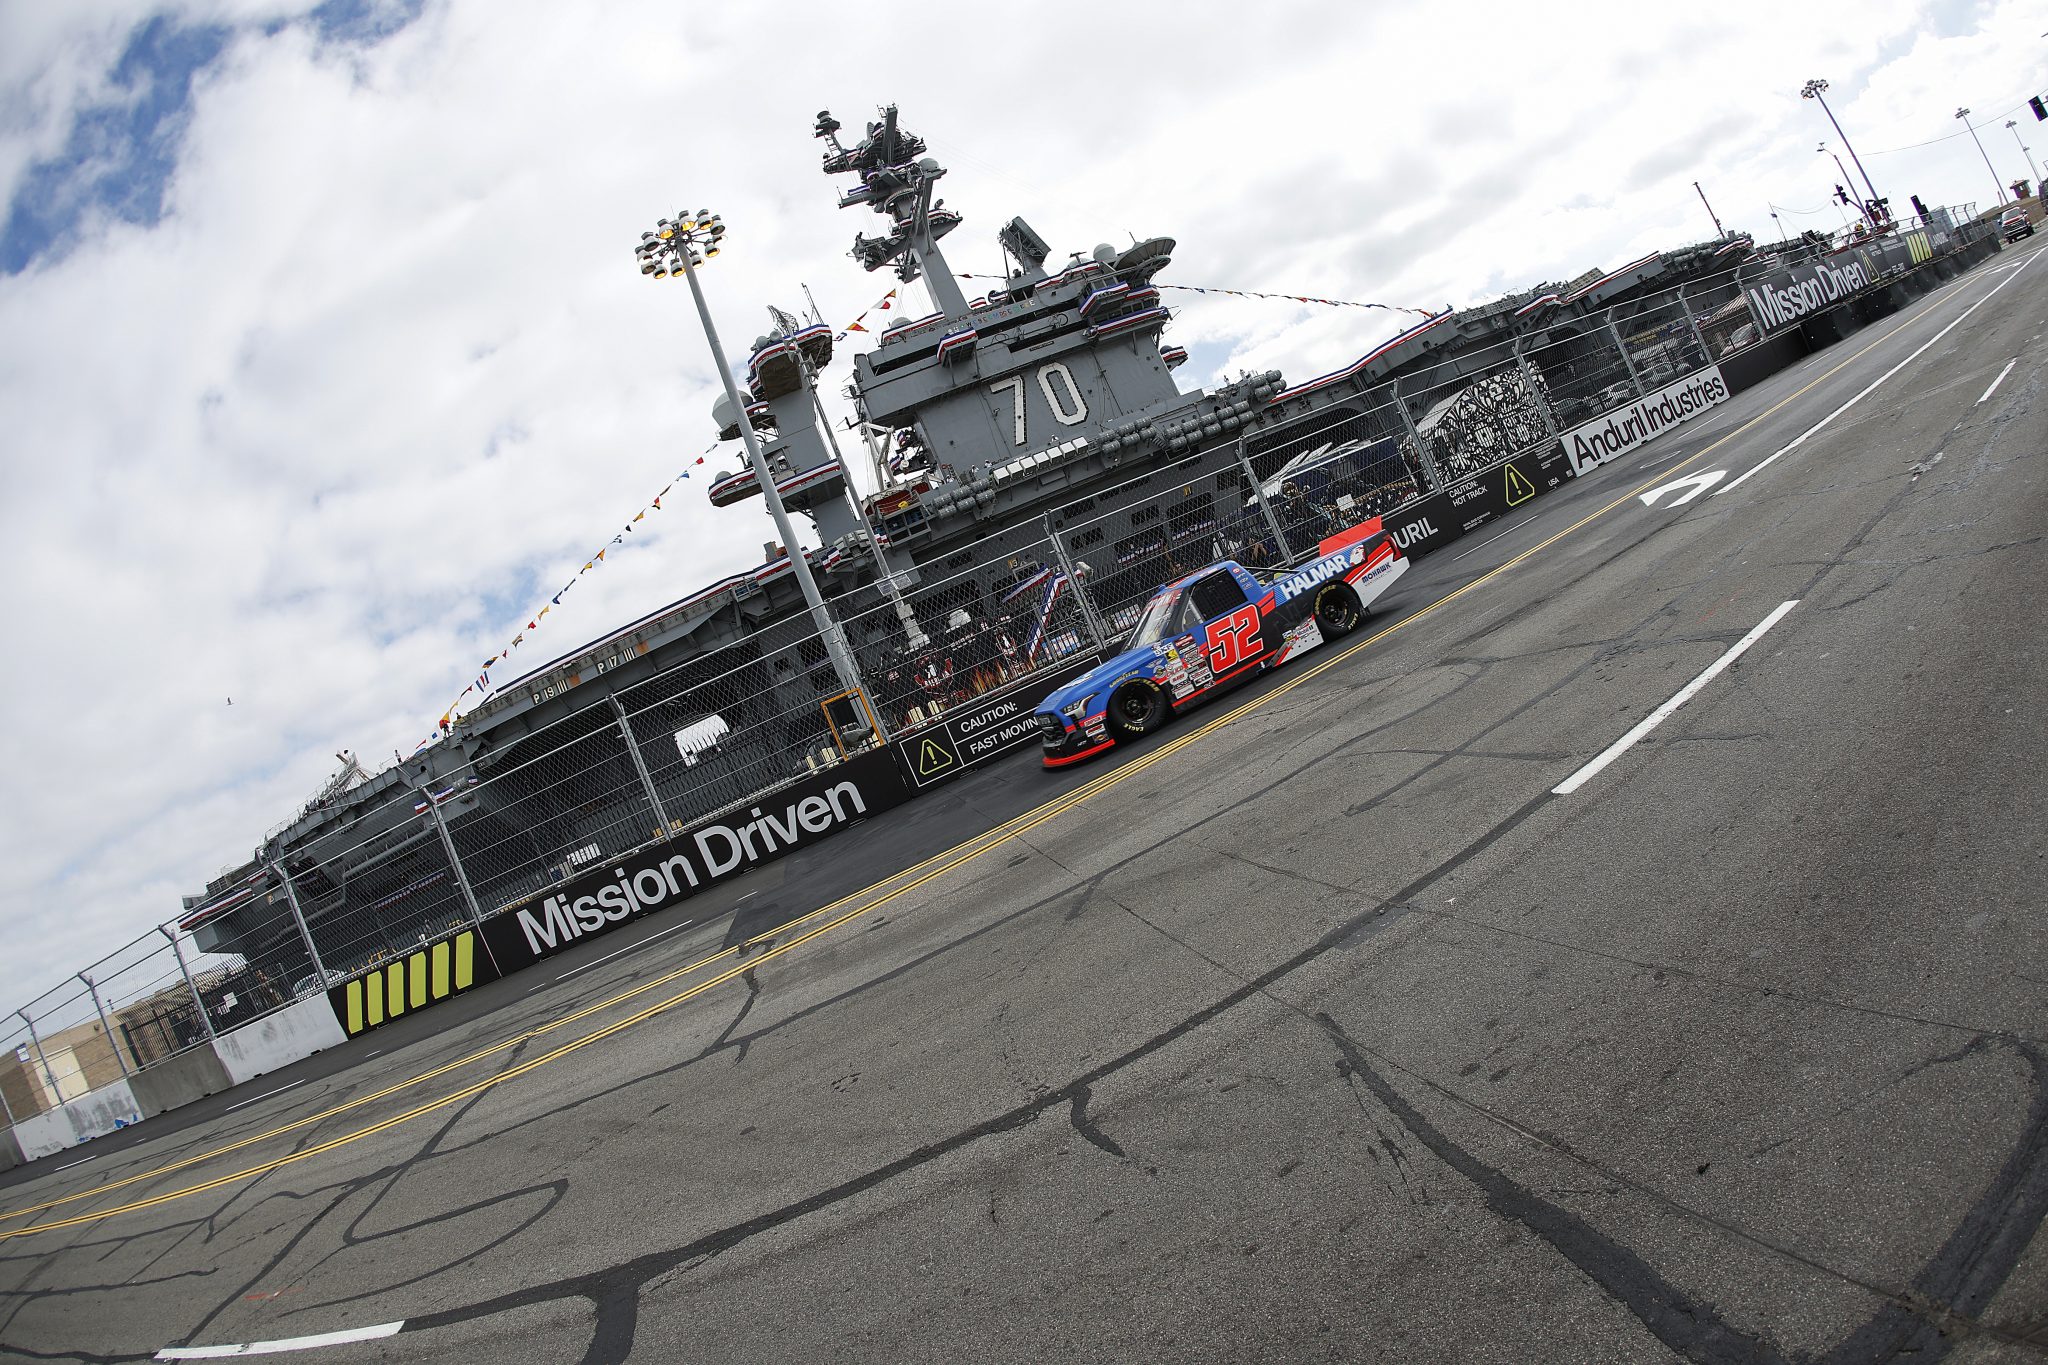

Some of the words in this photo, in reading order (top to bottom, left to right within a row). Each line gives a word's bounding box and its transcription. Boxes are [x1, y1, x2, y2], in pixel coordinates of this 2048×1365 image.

[1750, 274, 1827, 330] Mission
[1815, 261, 1868, 299] Driven
[990, 362, 1089, 446] 70
[1573, 406, 1648, 470] Anduril
[1641, 376, 1725, 432] Industries
[1448, 479, 1479, 498] CAUTION:
[1452, 495, 1467, 507] HOT
[1466, 484, 1488, 501] TRACK
[1547, 476, 1560, 487] USA
[1280, 555, 1350, 600] HALMAR
[1361, 562, 1391, 583] MOHAWK
[1204, 603, 1264, 674] 52
[597, 663, 605, 674] P
[608, 656, 617, 668] 17
[533, 694, 540, 704] P
[543, 687, 555, 699] 19
[960, 702, 1018, 733] CAUTION:
[1123, 722, 1144, 731] EAGLE
[969, 734, 999, 755] FAST
[1000, 716, 1039, 741] MOVIN
[516, 854, 699, 955] Mission
[694, 780, 866, 878] Driven
